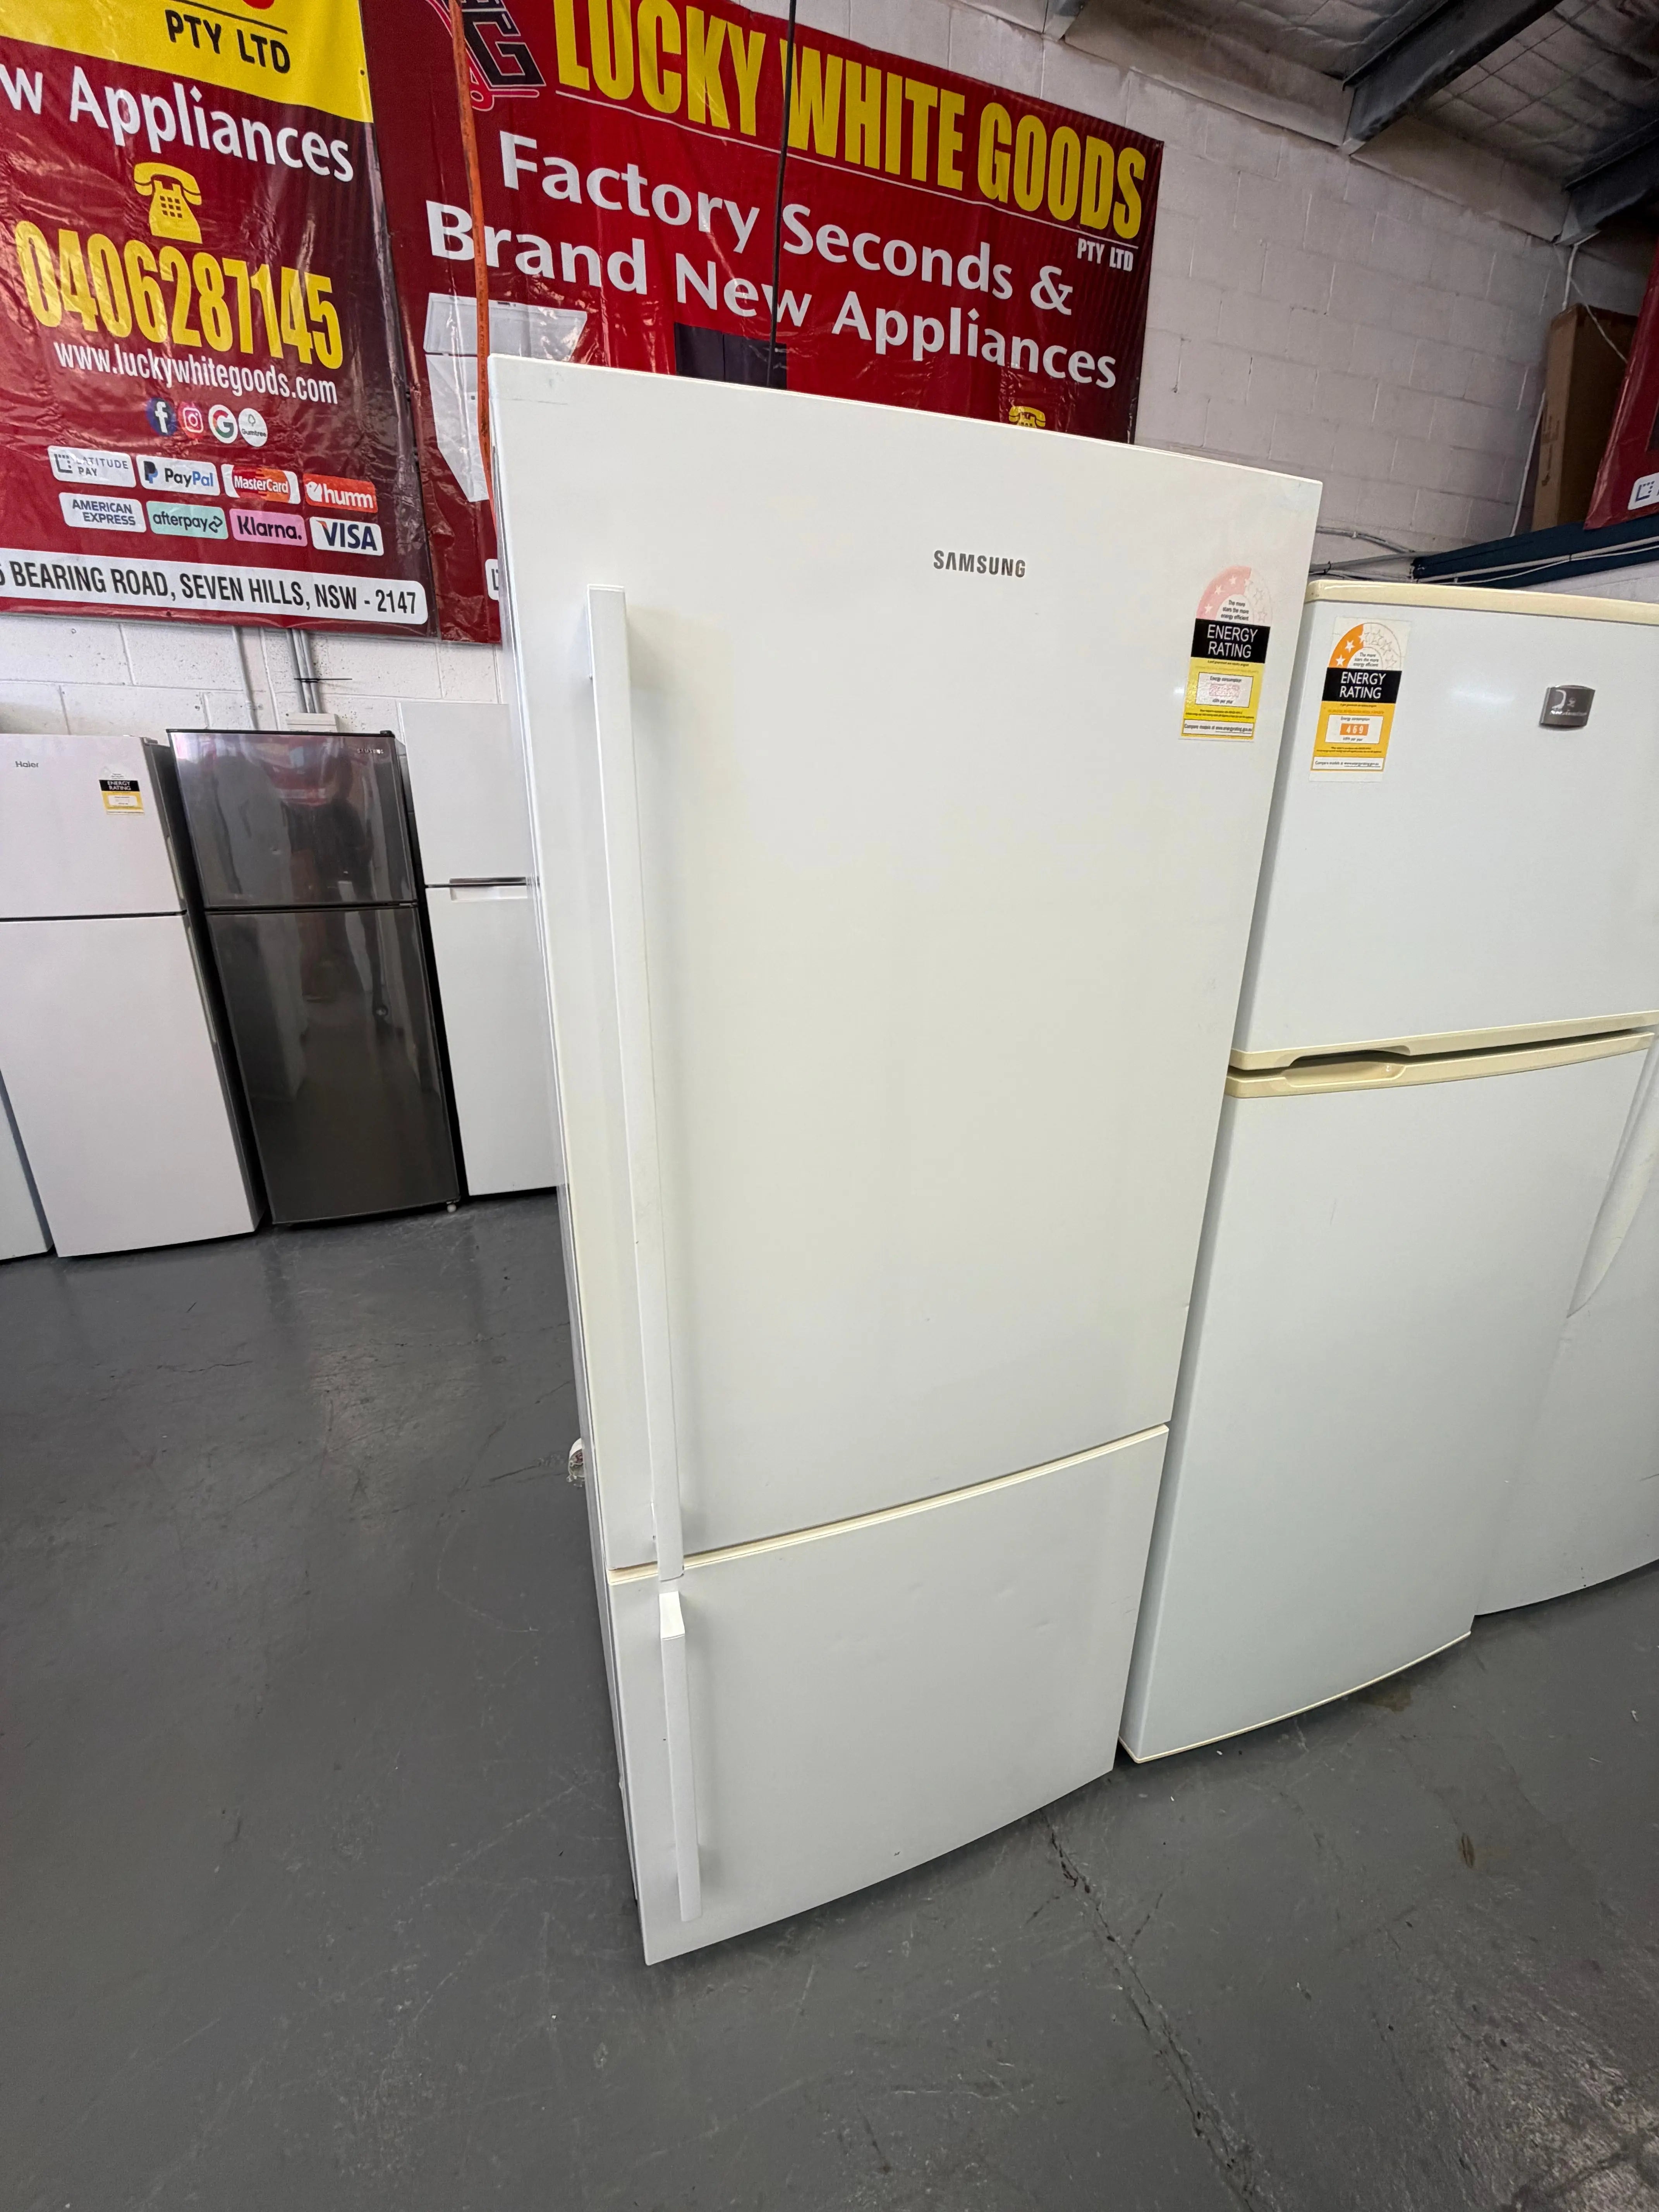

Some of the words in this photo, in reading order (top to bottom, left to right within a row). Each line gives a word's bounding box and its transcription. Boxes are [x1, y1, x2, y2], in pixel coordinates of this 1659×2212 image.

[165, 10, 221, 54] PTY
[237, 29, 290, 74] LTD
[70, 65, 354, 182] Appliances
[554, 0, 766, 136] LUCKY
[779, 38, 965, 191] WHITE
[977, 103, 1146, 239] GOODS
[499, 131, 759, 254] Factory
[782, 204, 1013, 299] Seconds
[1030, 266, 1073, 315] &
[1077, 237, 1105, 262] PTY
[1109, 249, 1133, 271] LTD
[15, 220, 343, 369] 0406287145
[426, 199, 647, 295] Brand
[675, 253, 812, 327] New
[831, 290, 1116, 388] Appliances
[54, 342, 338, 404] www.luckywhitegoods.com
[242, 428, 266, 437] Gumtree
[78, 467, 97, 476] PAY
[164, 468, 213, 488] PayPal
[234, 476, 289, 494] MasterCard
[323, 484, 374, 509] humm
[72, 499, 132, 514] AMERICAN
[84, 512, 136, 526] EXPRESS
[153, 511, 208, 532] afterpay
[237, 515, 302, 540] Klarna.
[317, 520, 378, 551] VISA
[933, 550, 1025, 578] SAMSUNG
[9, 561, 106, 593] BEARING
[110, 568, 176, 601] ROAD,
[179, 573, 244, 601] SEVEN
[249, 579, 310, 610] HILLS,
[314, 584, 357, 610] NSW
[375, 589, 416, 614] 2147
[1207, 624, 1258, 642] ENERGY
[1208, 641, 1252, 658] RATING
[1341, 671, 1386, 685] ENERGY
[1340, 685, 1382, 699] RATING
[1346, 725, 1364, 734] 469
